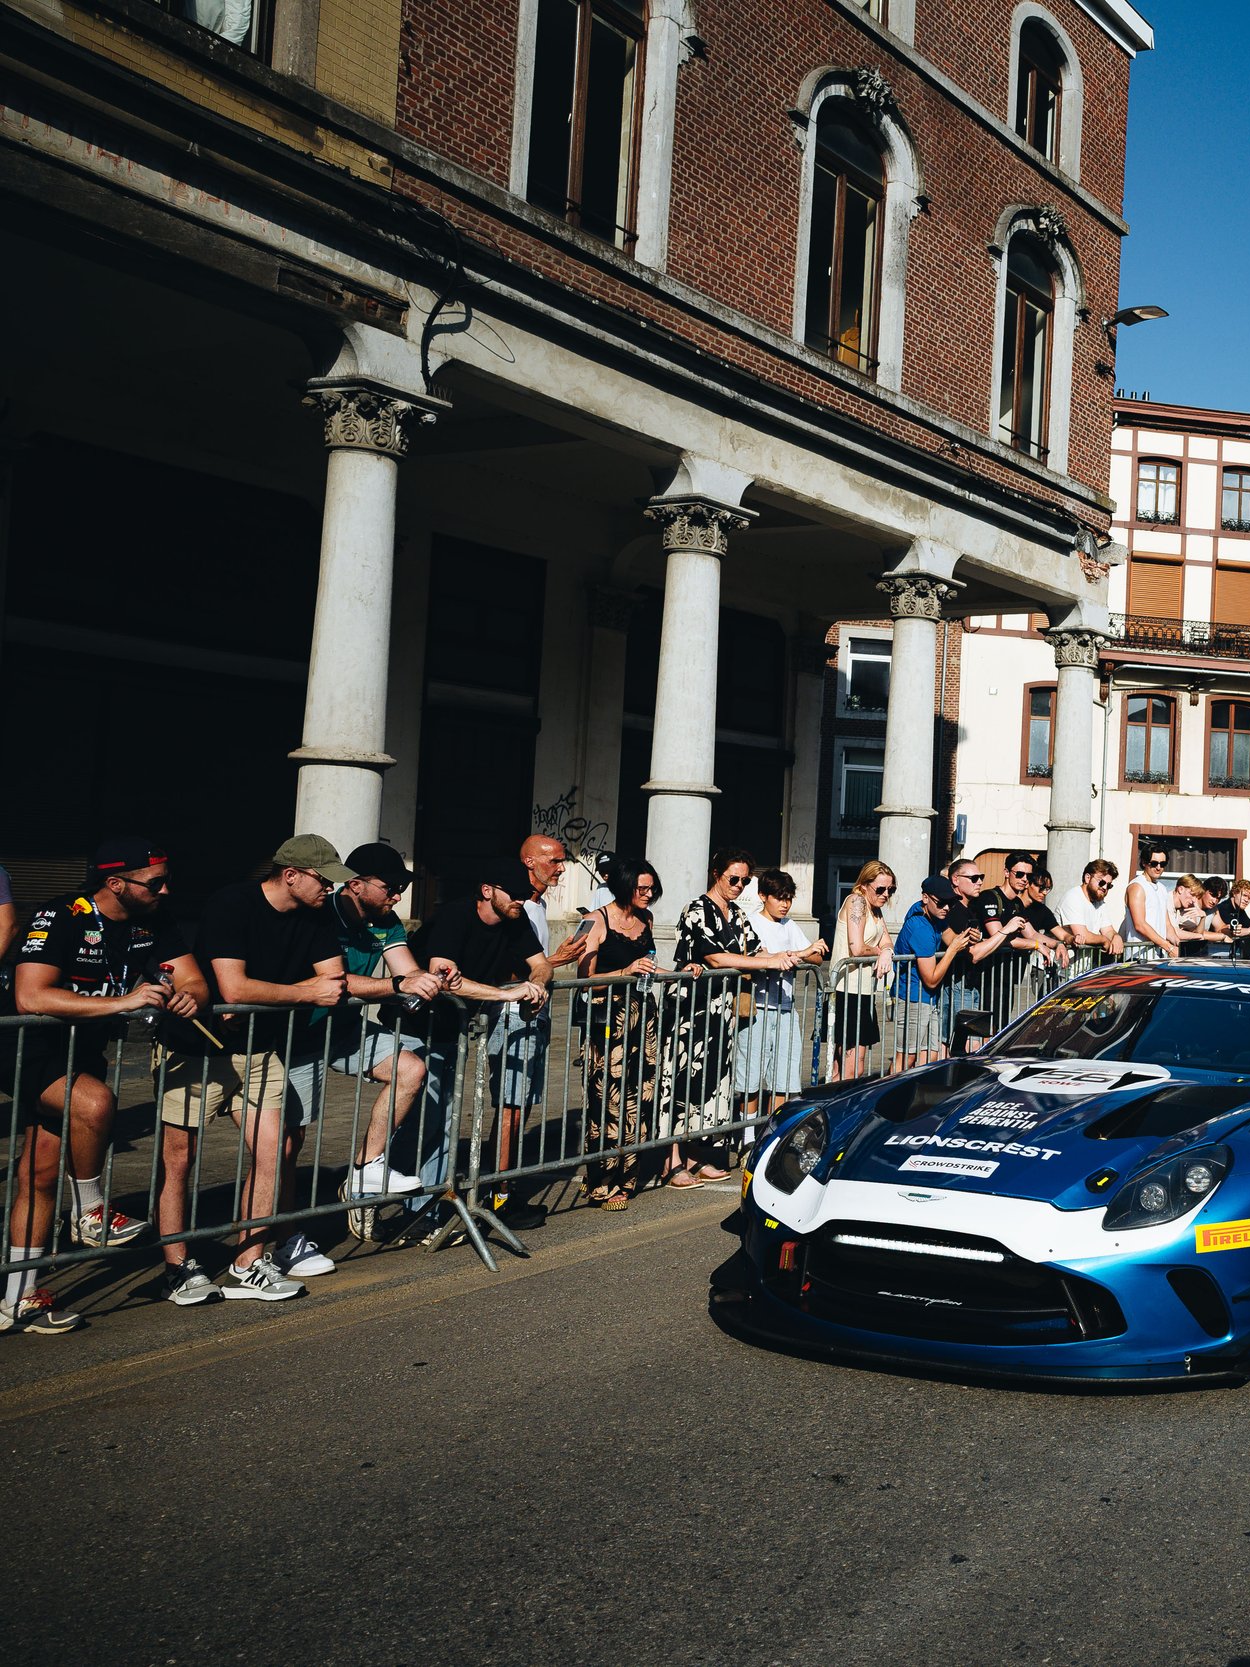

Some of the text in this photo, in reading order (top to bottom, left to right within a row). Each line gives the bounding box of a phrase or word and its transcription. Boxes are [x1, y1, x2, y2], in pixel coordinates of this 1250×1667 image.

[1031, 1070, 1122, 1083] 56
[1038, 1079, 1086, 1087] ROWE
[980, 1101, 1025, 1110] RACE
[968, 1108, 1039, 1120] AGAINST
[958, 1115, 1038, 1130] DEMENTIA
[884, 1134, 1062, 1161] LIONSCREST
[912, 1160, 993, 1173] CROWDSTRIKE
[764, 1218, 780, 1230] TOW
